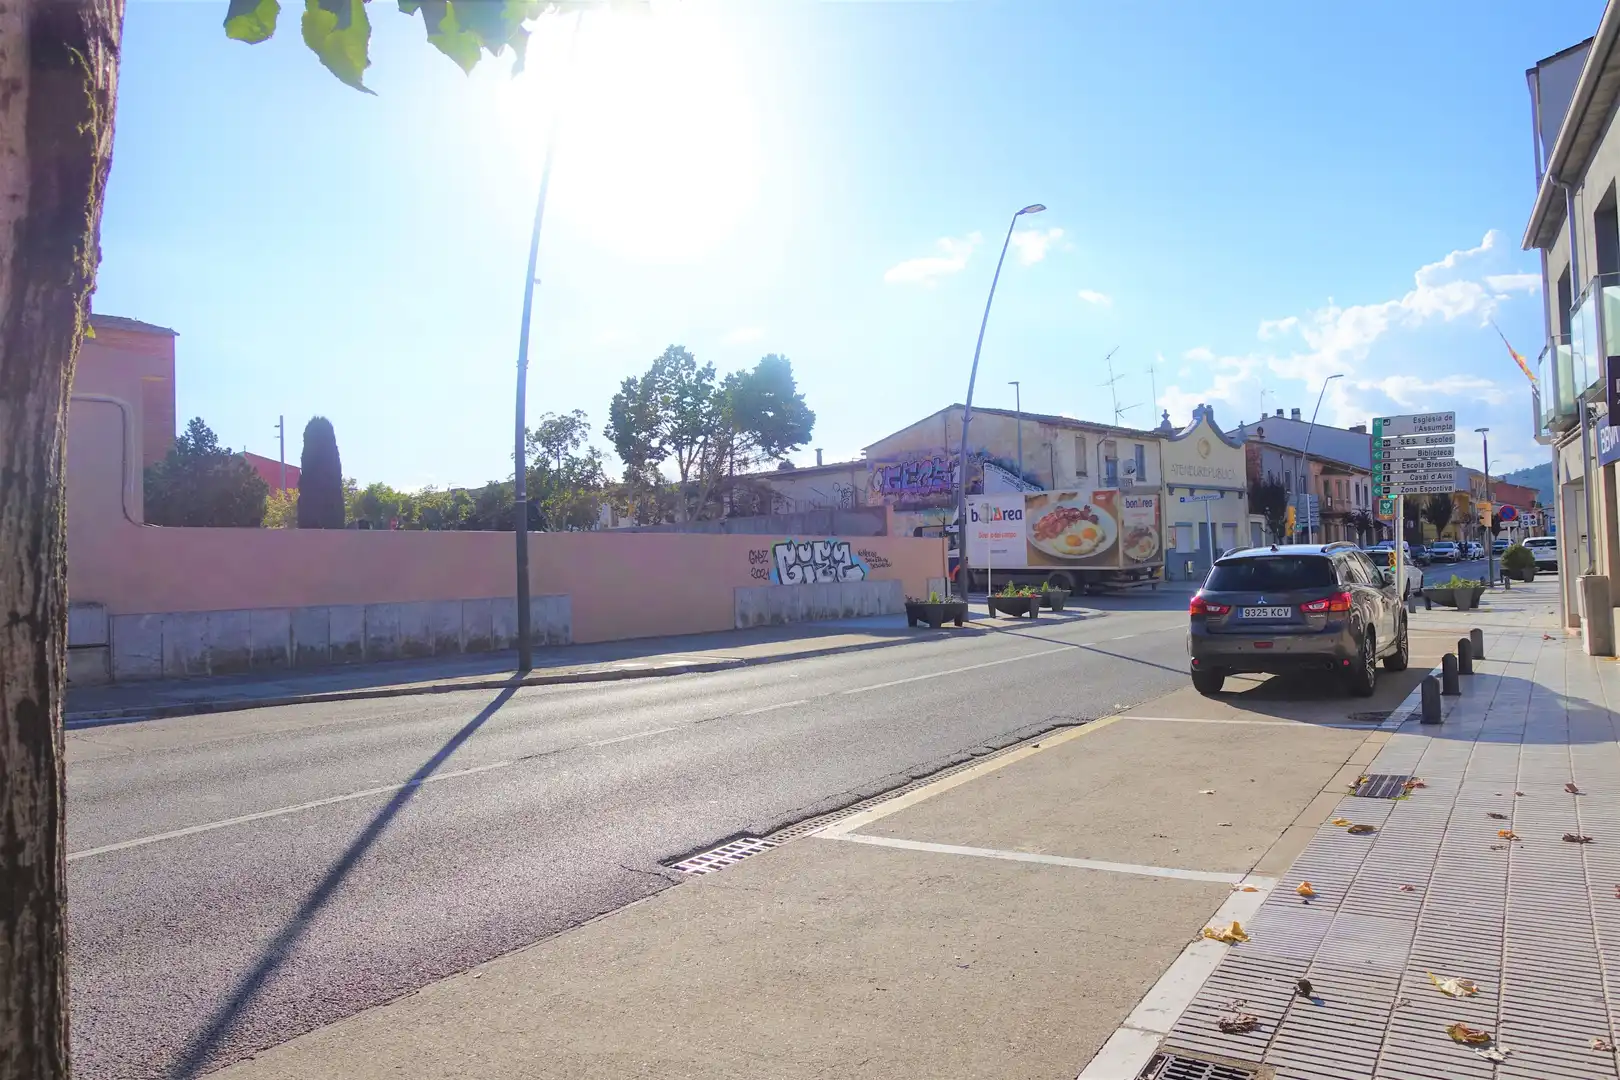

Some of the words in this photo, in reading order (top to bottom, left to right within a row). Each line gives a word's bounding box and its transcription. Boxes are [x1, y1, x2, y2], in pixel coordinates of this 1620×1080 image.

[1414, 424, 1452, 432] l'Assumpta
[1600, 425, 1619, 454] BBVA
[1244, 608, 1268, 617] 9325
[1271, 608, 1289, 617] KCV
